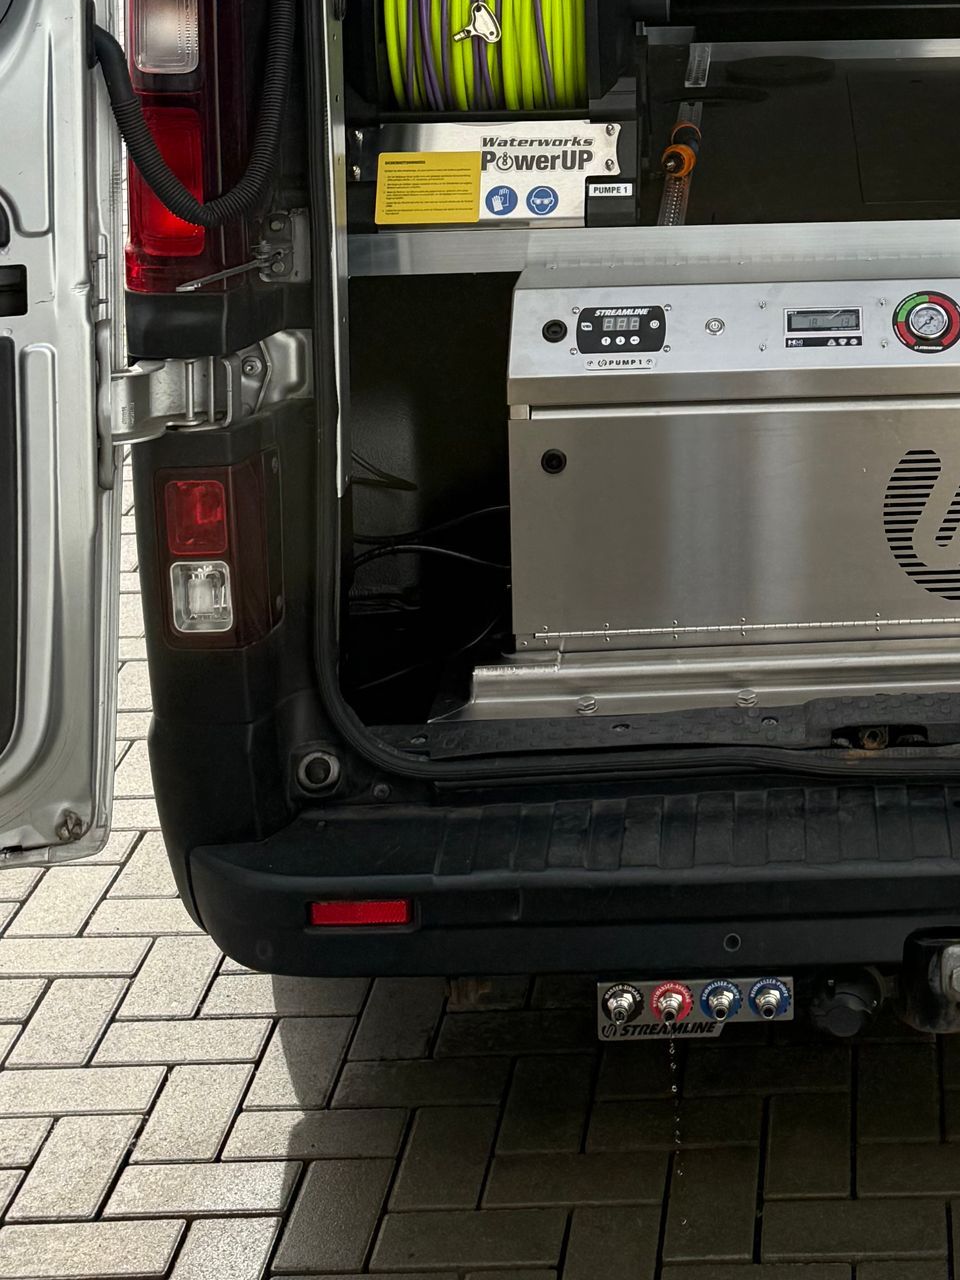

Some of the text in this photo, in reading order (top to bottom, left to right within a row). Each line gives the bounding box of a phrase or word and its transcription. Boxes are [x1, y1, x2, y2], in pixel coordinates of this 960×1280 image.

[482, 136, 593, 147] Waterworks
[593, 186, 628, 194] PUMPE 1
[594, 308, 650, 317] STREAMLINE
[620, 1021, 717, 1037] STREAMLINE
